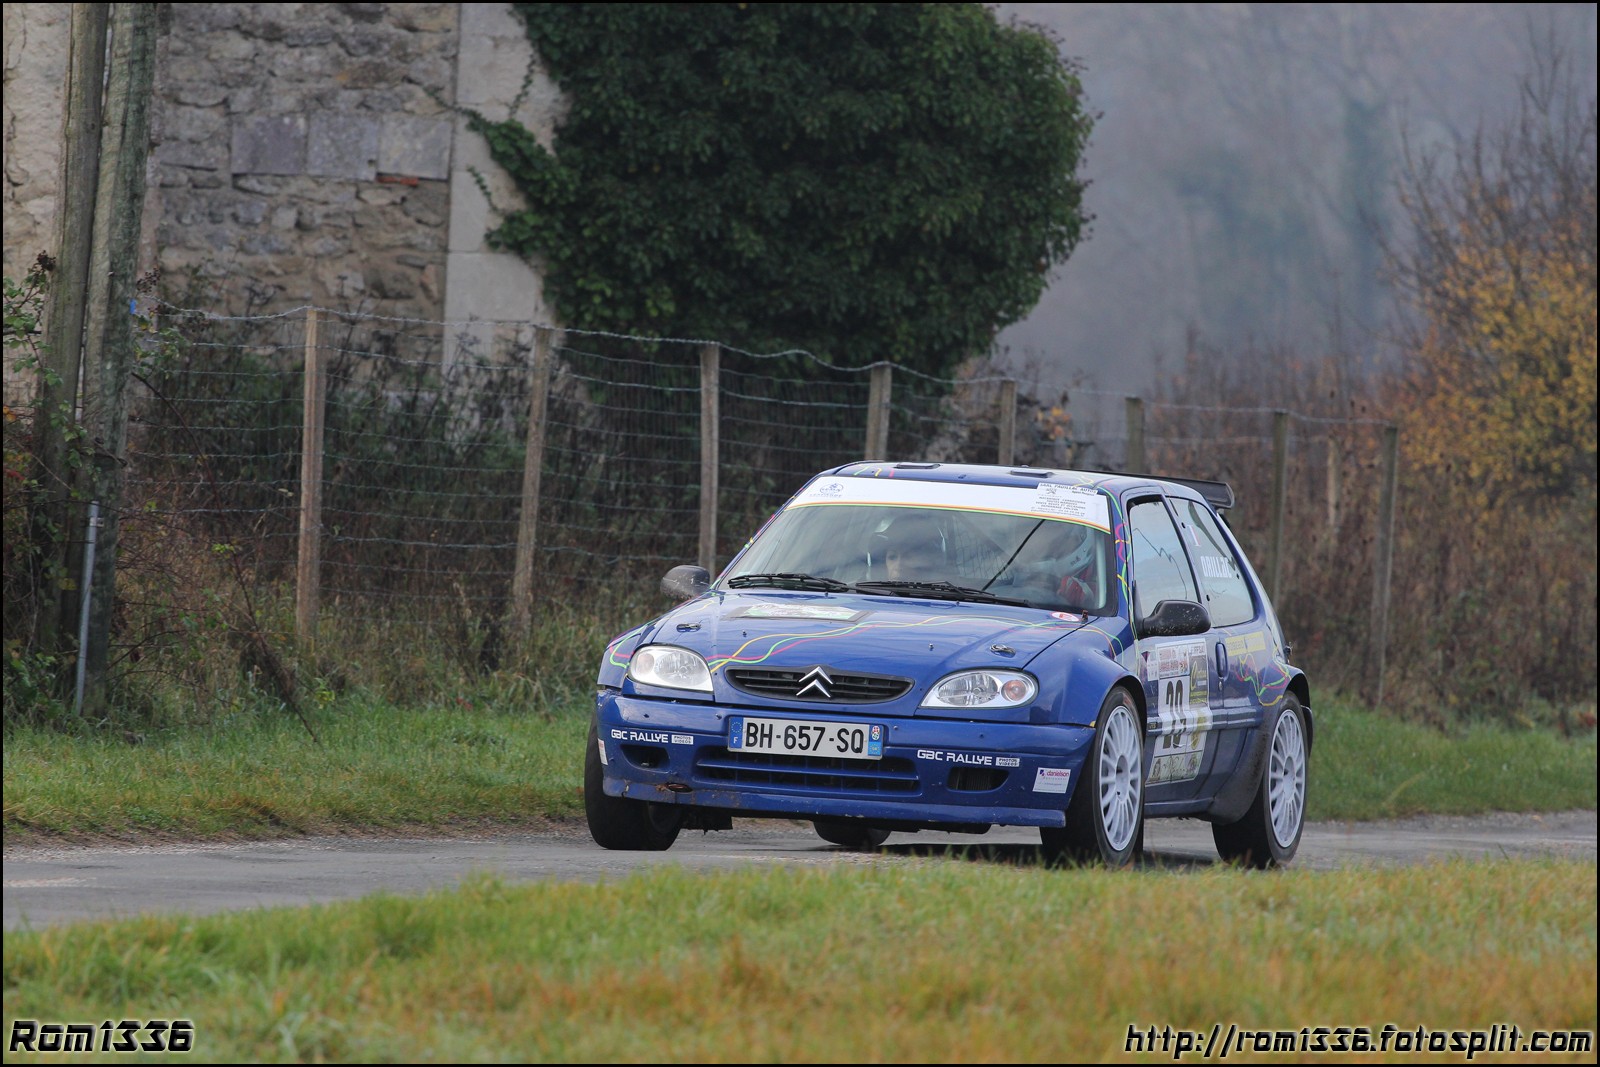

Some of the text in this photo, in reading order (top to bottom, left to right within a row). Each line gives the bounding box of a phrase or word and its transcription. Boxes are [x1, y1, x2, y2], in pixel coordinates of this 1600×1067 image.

[611, 728, 669, 743] GBC RALLYE
[745, 722, 864, 753] BH-657-SQ
[917, 749, 993, 765] GBC RALLYE
